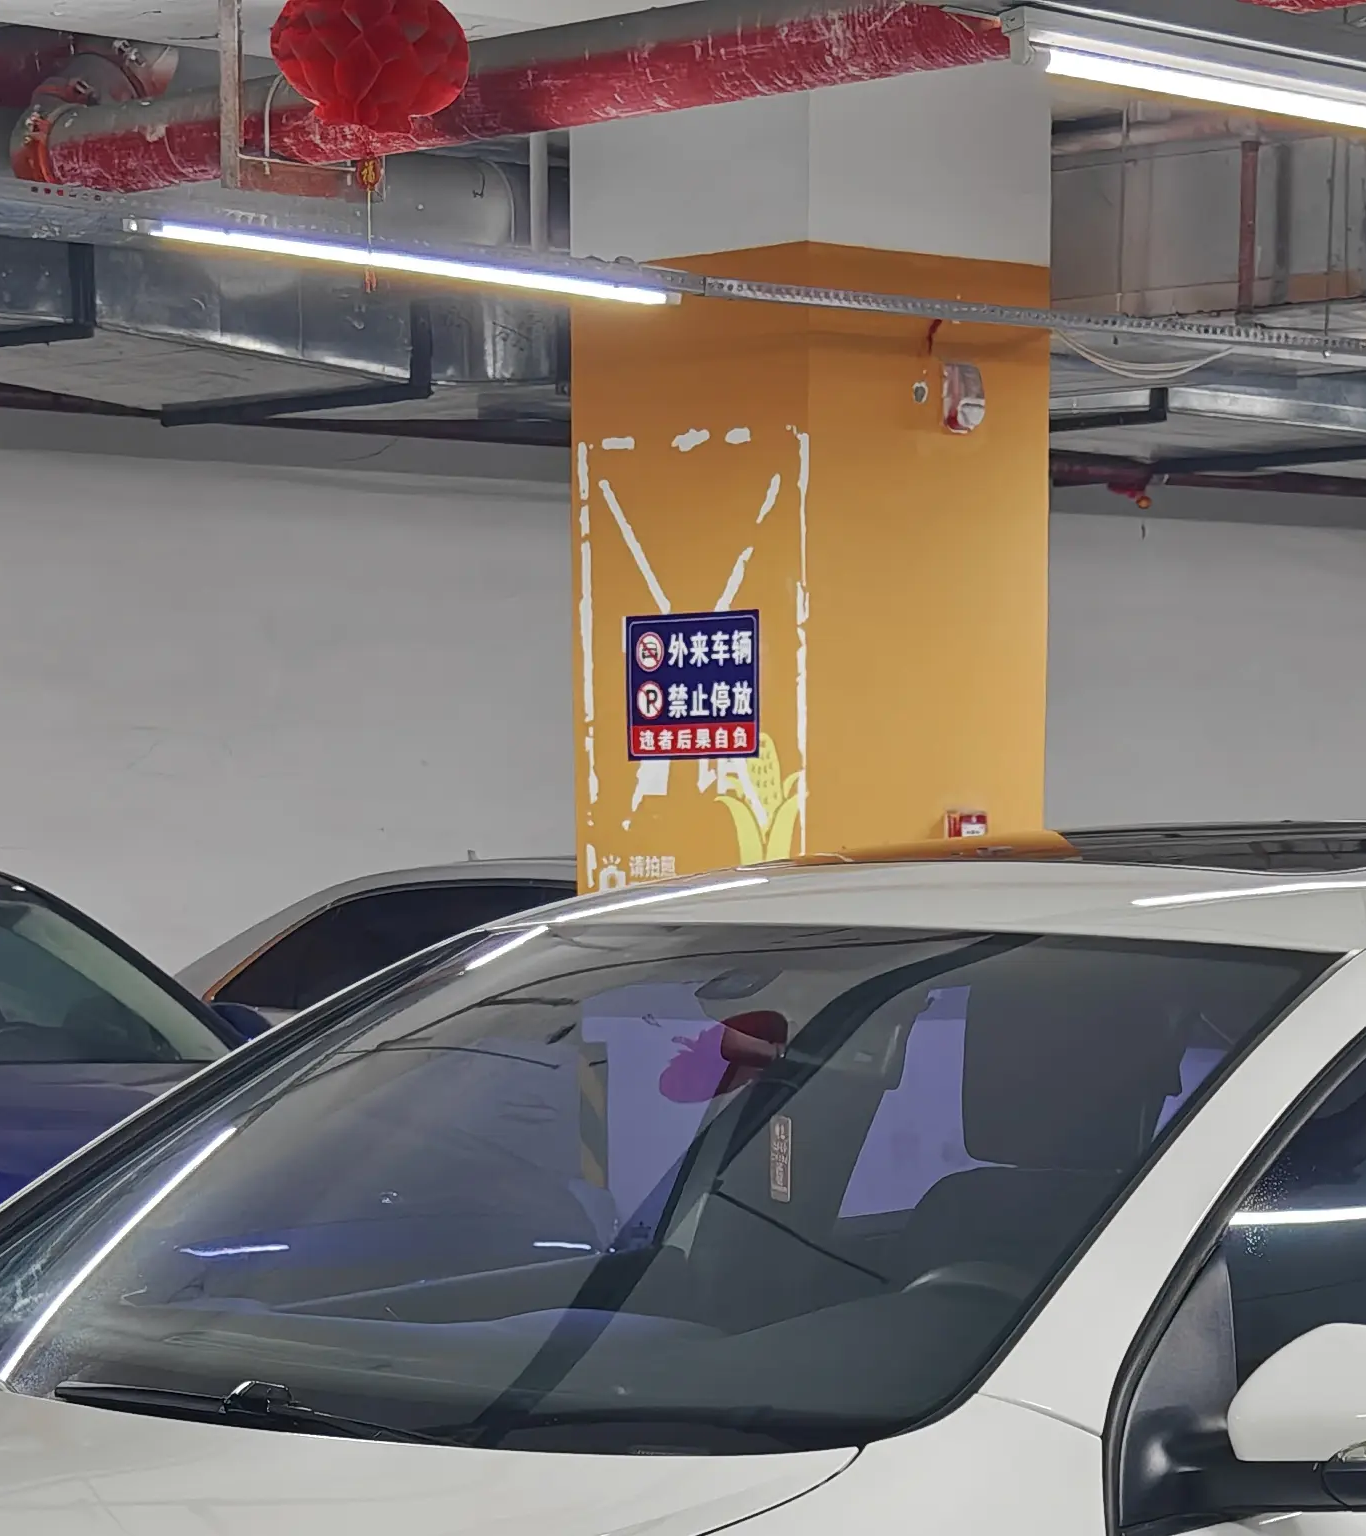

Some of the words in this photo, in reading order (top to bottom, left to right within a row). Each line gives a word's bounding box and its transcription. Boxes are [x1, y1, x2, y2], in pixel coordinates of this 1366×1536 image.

[667, 630, 752, 668] 外来车辆
[667, 680, 753, 718] 禁止停放
[639, 726, 748, 751] 违者后果自负
